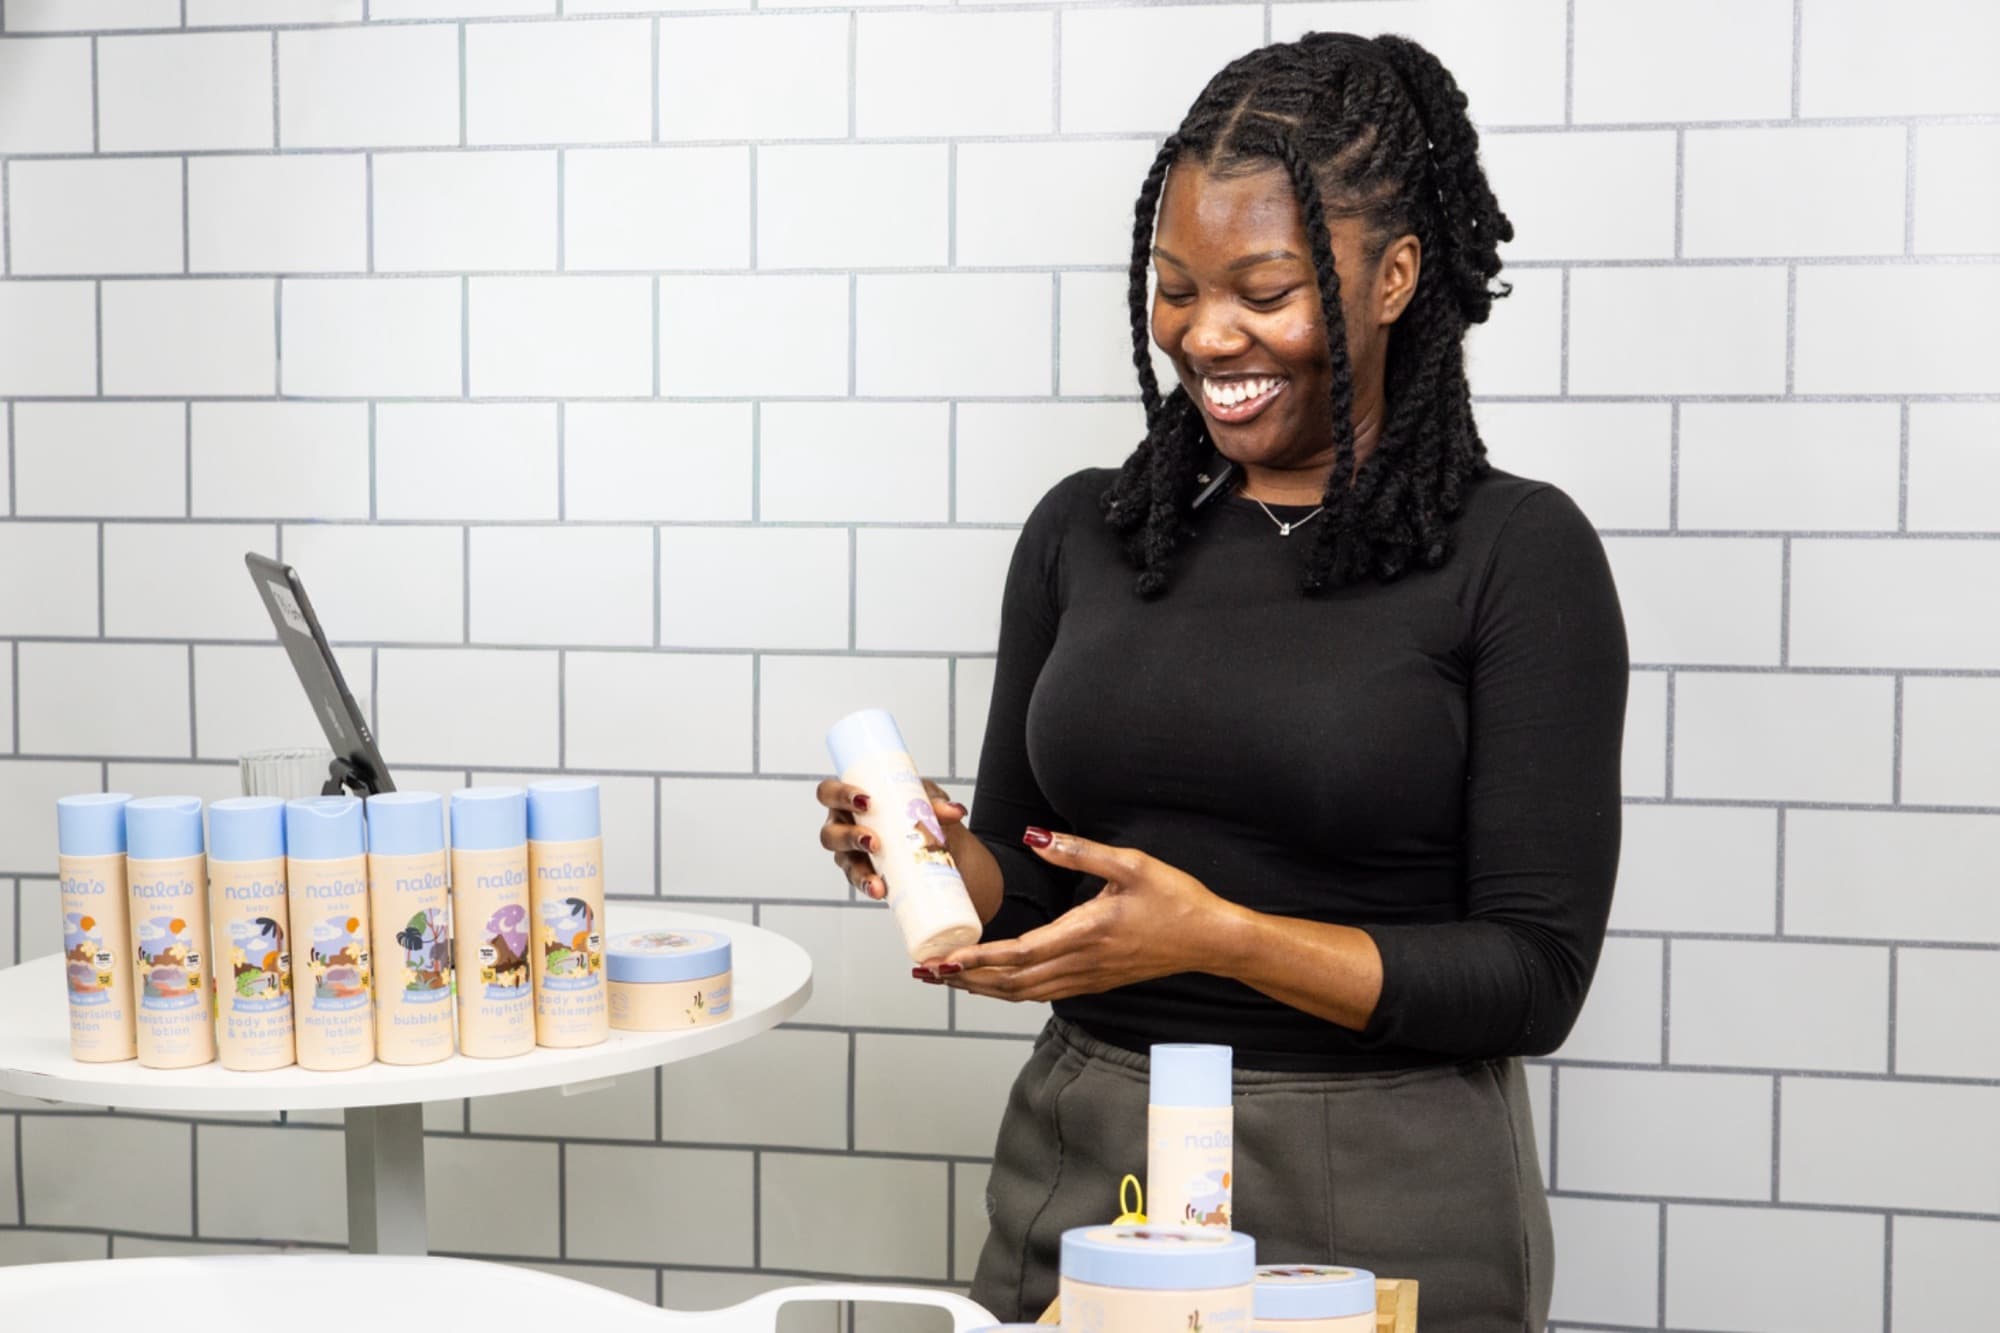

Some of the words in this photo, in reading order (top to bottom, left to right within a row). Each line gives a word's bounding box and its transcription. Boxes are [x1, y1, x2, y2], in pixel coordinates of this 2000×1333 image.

[537, 862, 597, 880] nala's
[61, 877, 105, 895] ala's
[132, 880, 195, 898] nala's
[224, 880, 285, 900] nala's
[305, 879, 366, 899] nala's
[538, 991, 569, 1007] body
[575, 990, 604, 1004] wash
[139, 1010, 208, 1025] moisturising
[227, 1015, 260, 1028] body
[393, 1012, 439, 1025] bubble
[509, 1015, 524, 1025] oil
[151, 1026, 190, 1037] lotion
[325, 1027, 362, 1038] lotion
